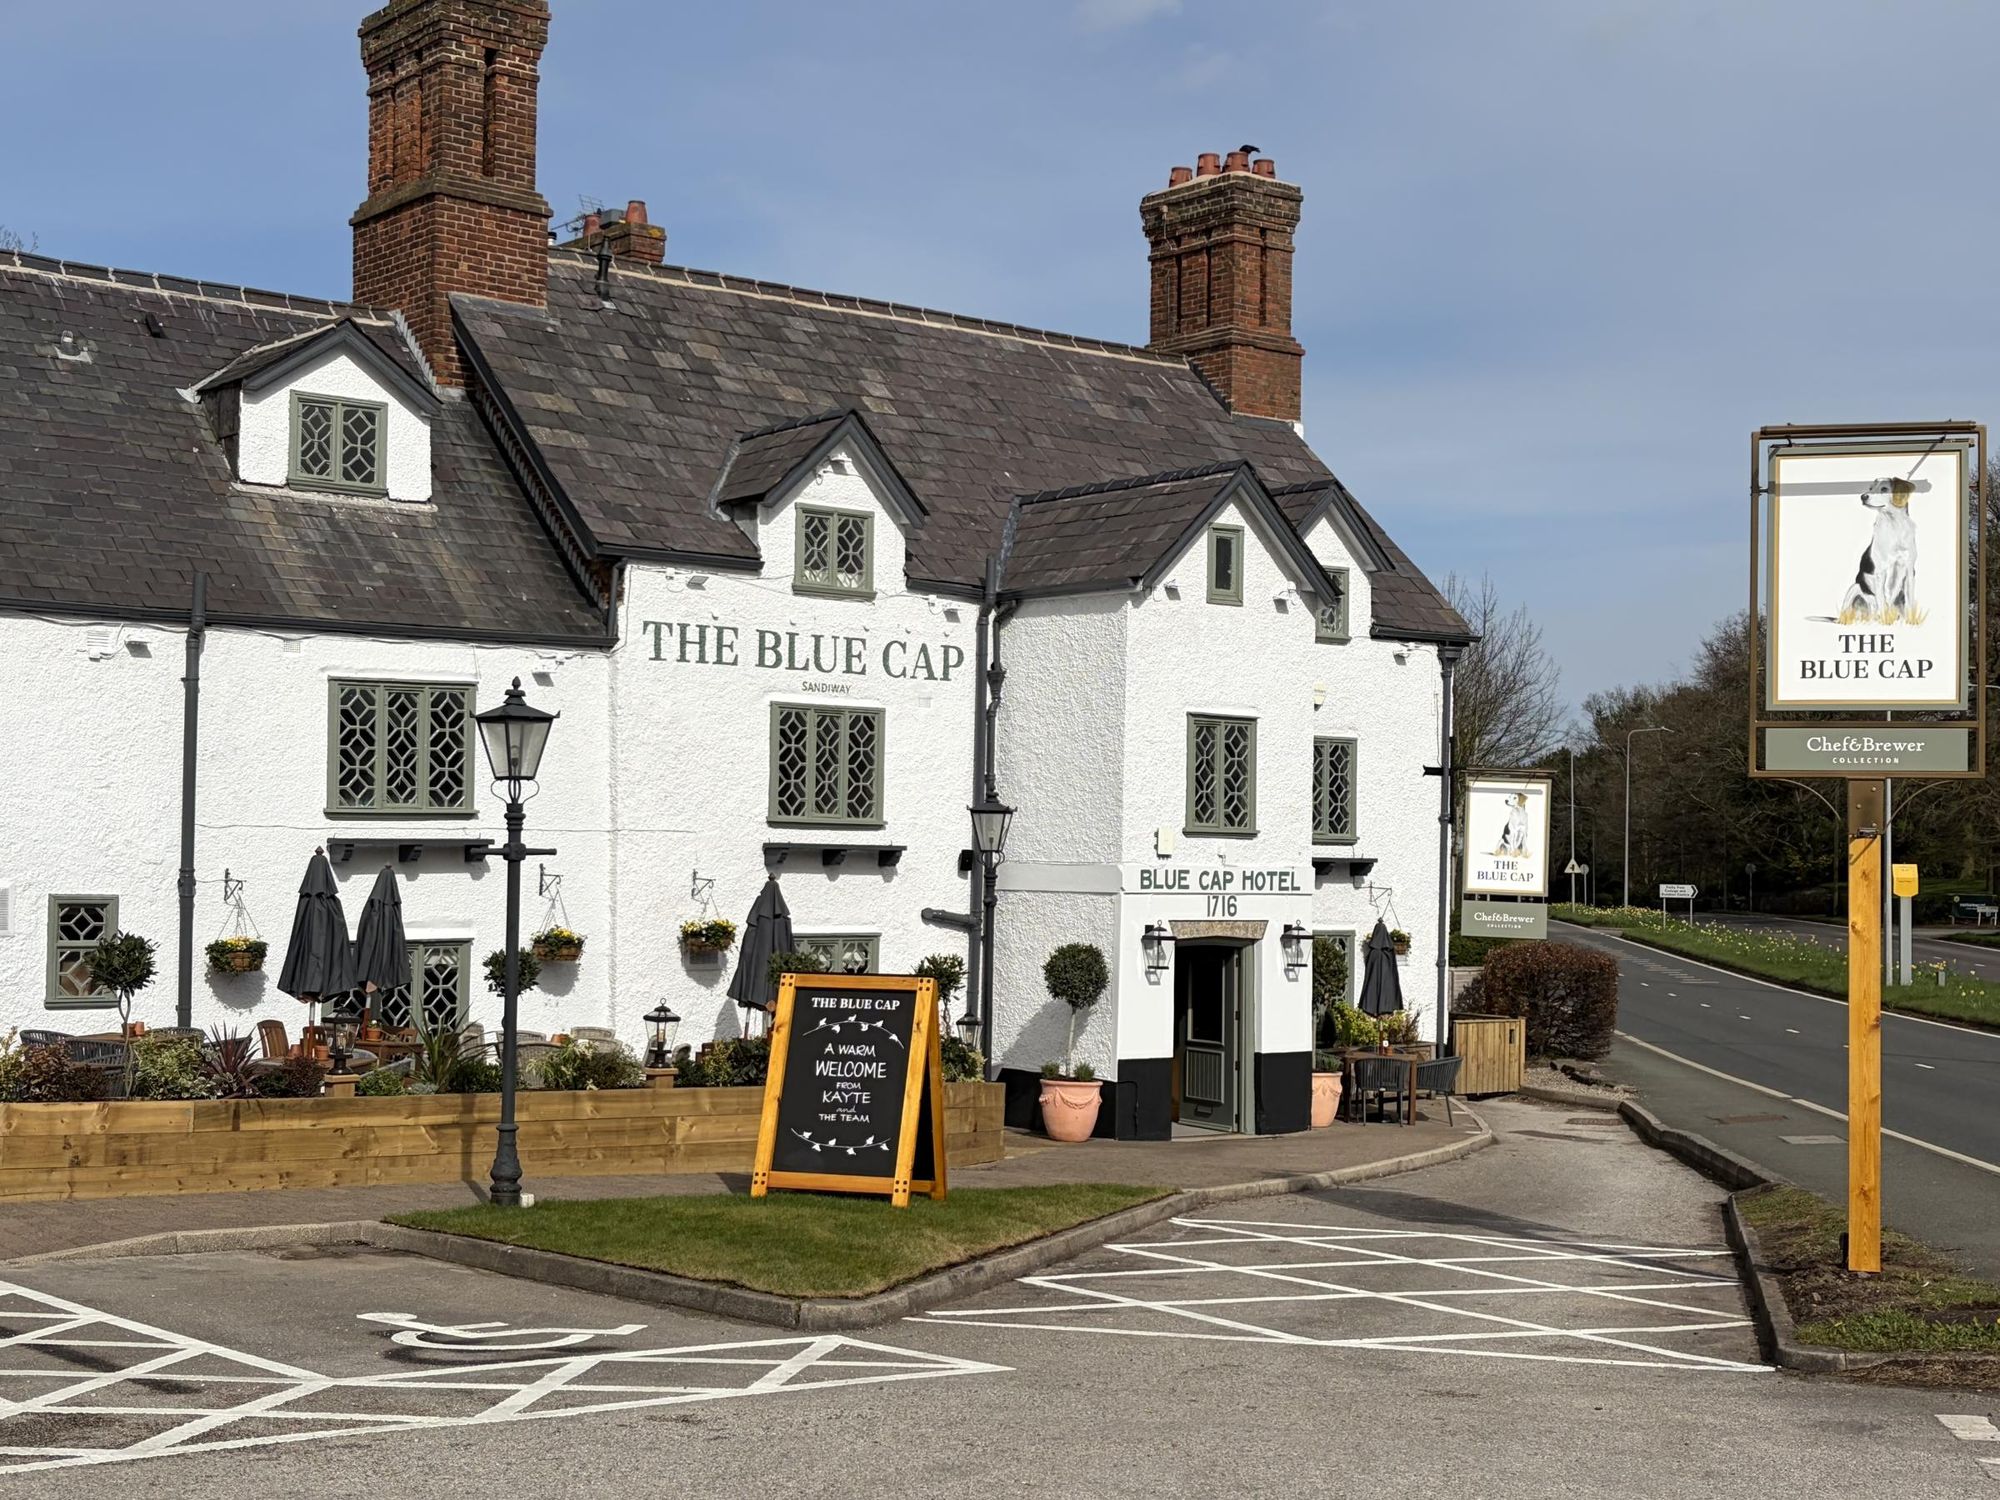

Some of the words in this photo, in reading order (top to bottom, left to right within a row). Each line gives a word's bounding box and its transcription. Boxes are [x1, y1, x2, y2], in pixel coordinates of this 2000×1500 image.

[1838, 633, 1895, 654] THE
[642, 620, 739, 666] THE
[755, 628, 867, 676] BLUE
[882, 640, 965, 682] CAP
[1800, 659, 1869, 679] BLUE
[1878, 659, 1933, 679] CAP
[801, 680, 852, 694] SANDIWAY
[1806, 736, 1925, 752] Chef&Brewer
[1493, 860, 1518, 870] THE
[1140, 869, 1190, 890] BLUE
[1199, 870, 1234, 891] CAP
[1242, 870, 1301, 892] HOTEL
[1477, 871, 1507, 881] BLUE
[1510, 872, 1534, 882] CAP
[1207, 895, 1238, 917] 1716
[1474, 912, 1535, 924] Chef&Brewer
[811, 997, 837, 1009] THE
[839, 998, 872, 1010] BLUE
[874, 999, 900, 1011] CAP
[824, 1043, 834, 1054] A
[838, 1044, 876, 1057] WARM
[815, 1060, 887, 1079] WELCOME
[836, 1081, 861, 1090] FROM
[822, 1091, 871, 1104] KAYTE
[836, 1105, 856, 1113] and
[818, 1113, 837, 1122] THE
[839, 1113, 870, 1123] TEAM
